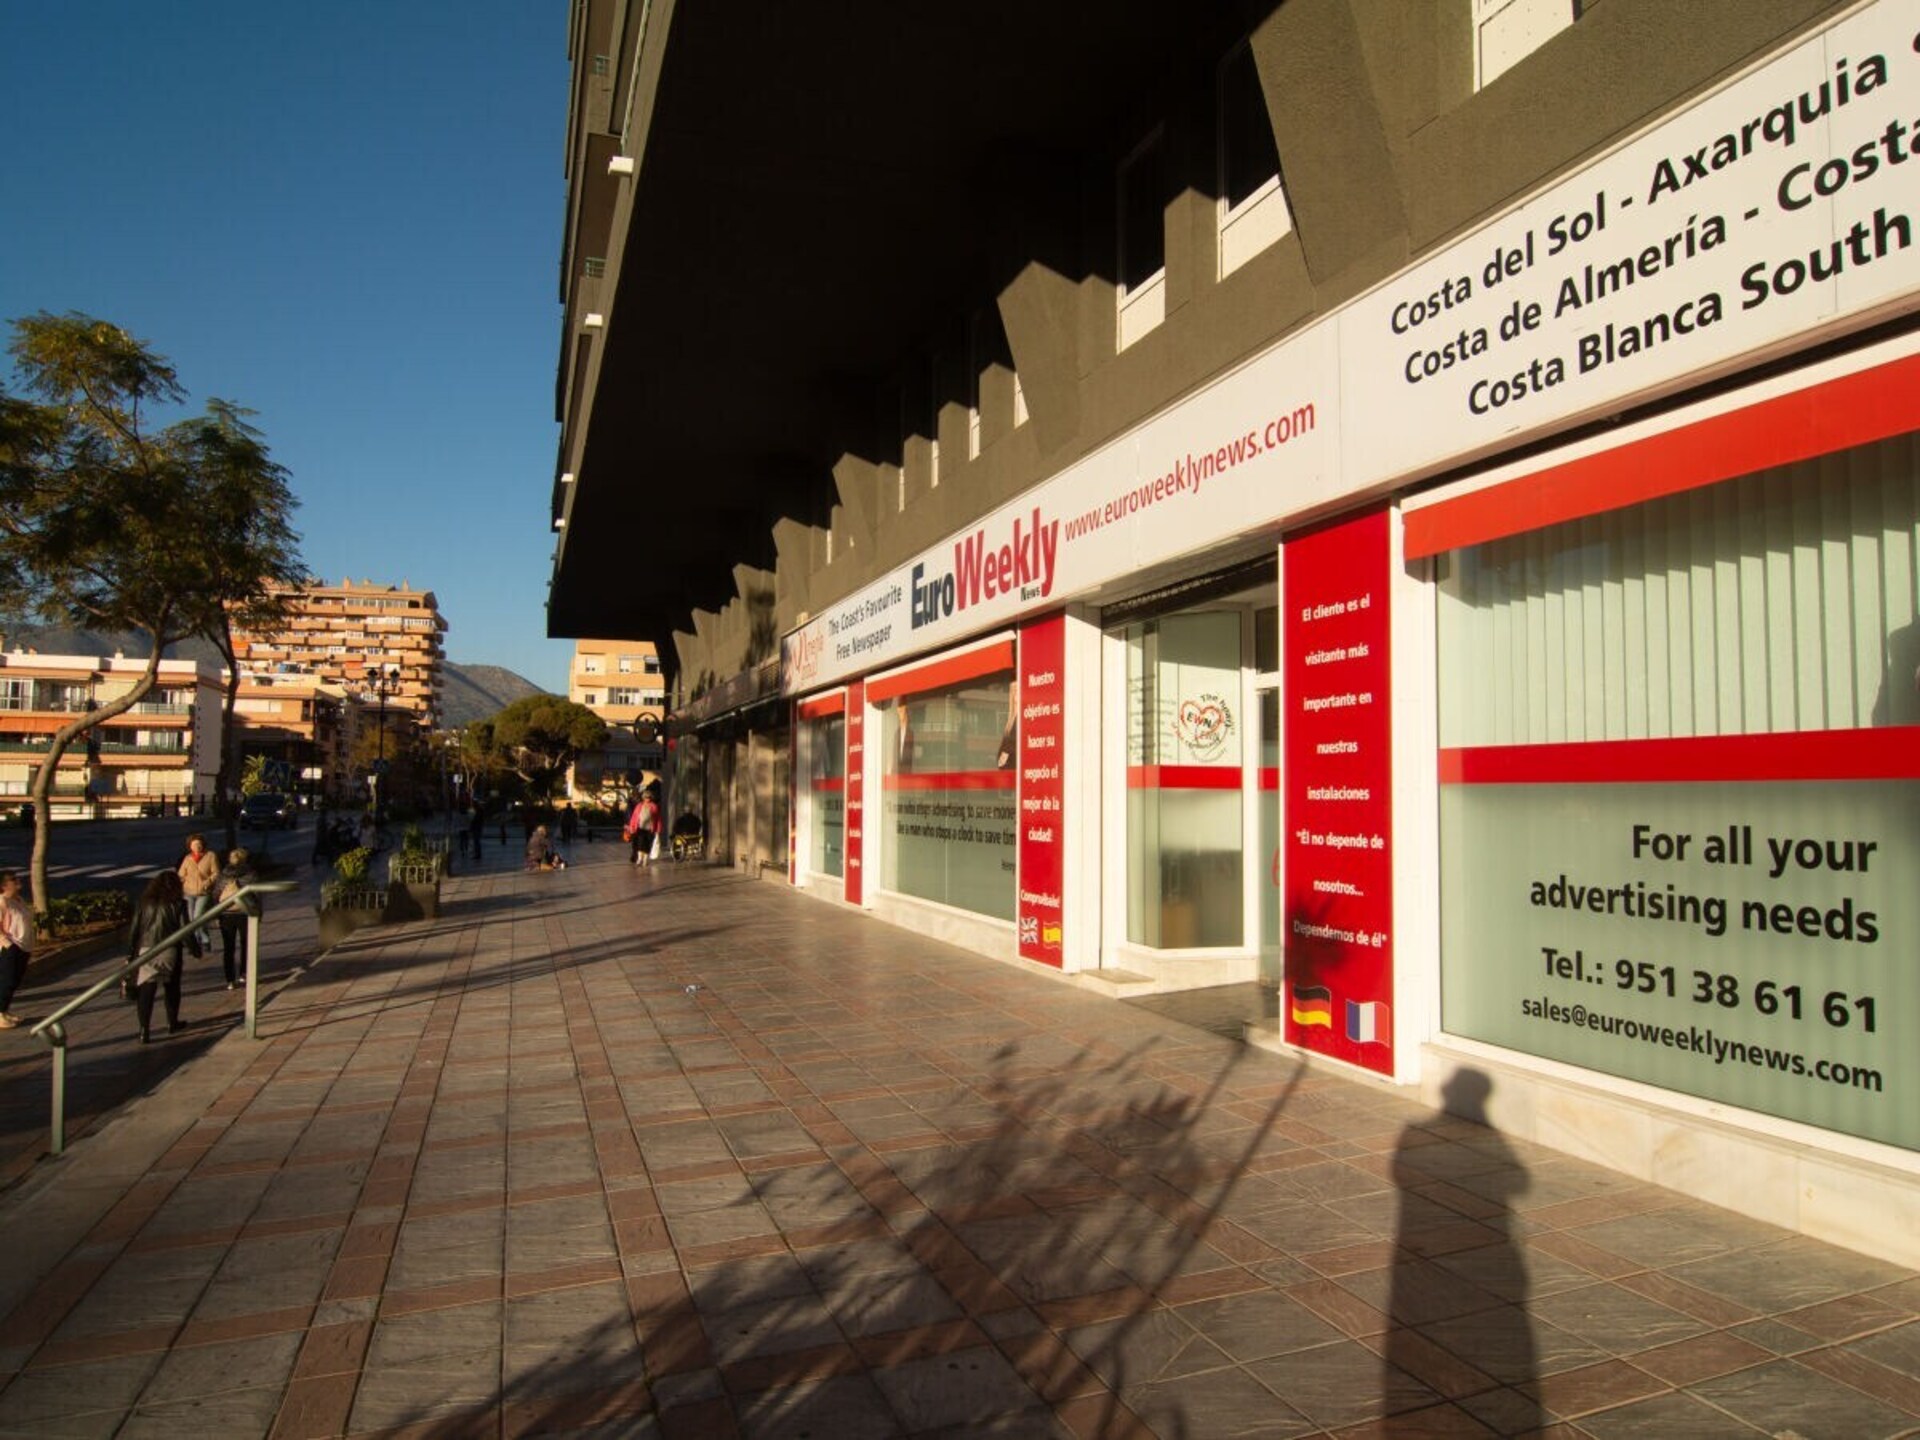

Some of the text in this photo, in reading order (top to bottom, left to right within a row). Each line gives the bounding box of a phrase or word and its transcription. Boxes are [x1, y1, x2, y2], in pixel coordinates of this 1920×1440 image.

[1390, 276, 1472, 335] Costa
[1483, 230, 1534, 289] del
[1548, 190, 1605, 257] Sol
[1648, 53, 1887, 206] Axarquia
[1404, 327, 1489, 385] Costa
[1500, 300, 1542, 342] de
[1555, 213, 1726, 319] Almería
[1468, 207, 1911, 415] Costa Blanca South
[1064, 402, 1315, 541] www.euroweeklynews.com
[828, 584, 902, 636] The Coast's Favourite
[1302, 592, 1371, 622] El cliente es el
[836, 642, 851, 661] Free
[852, 623, 893, 656] Newspaper
[1305, 642, 1369, 666] visitante más
[1028, 671, 1055, 688] Nuestro
[1023, 702, 1051, 721] objetivo
[1303, 692, 1372, 713] importante en
[1316, 740, 1358, 754] nuestras
[1307, 786, 1370, 800] instalaciones
[1311, 833, 1325, 846] no
[1326, 831, 1368, 850] depende
[1370, 834, 1385, 849] de
[1633, 824, 1878, 879] For all your
[1530, 874, 1879, 943] advertising needs
[1293, 919, 1354, 944] Dependemos
[1356, 930, 1369, 947] de
[1541, 947, 1876, 1034] Tel.: 951 38 61 61
[1522, 996, 1883, 1092] sales@euroweeklynews.com
